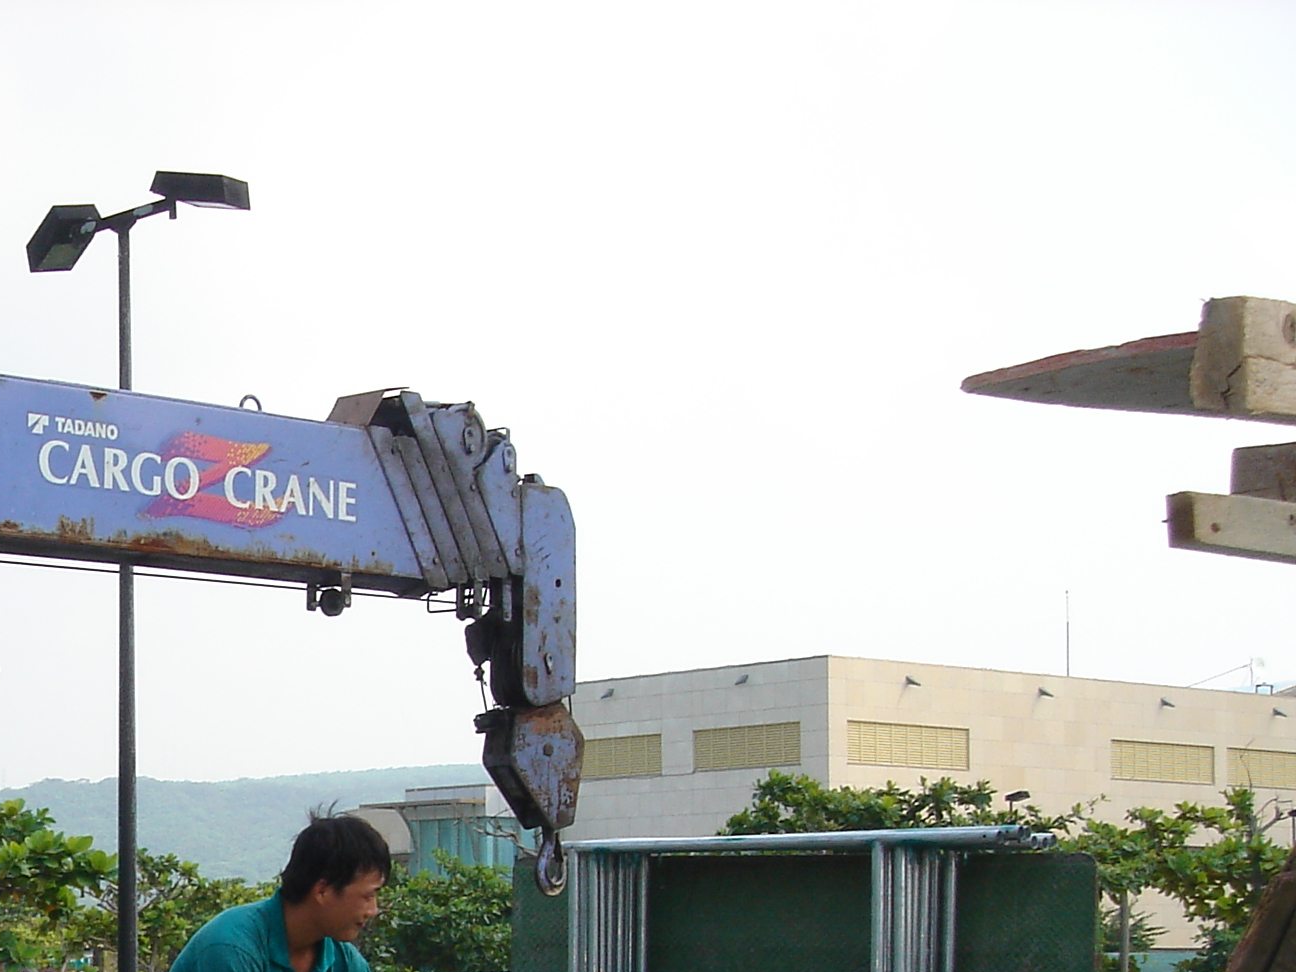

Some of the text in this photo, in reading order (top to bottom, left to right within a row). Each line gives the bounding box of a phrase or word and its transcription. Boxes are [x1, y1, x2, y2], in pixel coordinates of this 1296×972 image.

[55, 416, 118, 440] TADANO
[39, 440, 199, 500] CARGO
[224, 466, 357, 522] CRANE
